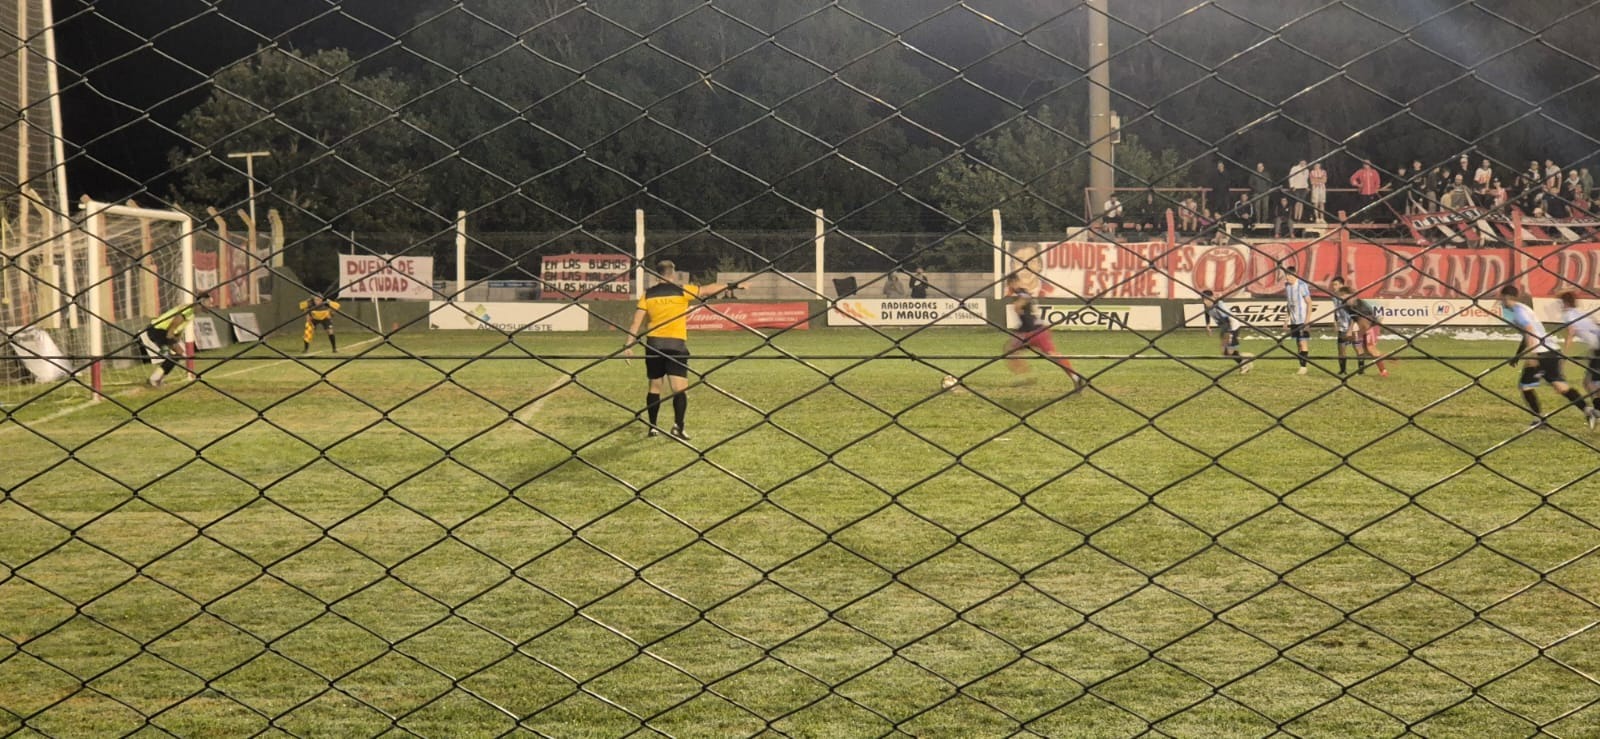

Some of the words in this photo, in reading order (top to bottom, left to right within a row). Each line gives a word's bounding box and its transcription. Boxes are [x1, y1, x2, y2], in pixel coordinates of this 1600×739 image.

[1047, 243, 1109, 271] DONDE
[398, 260, 415, 275] DE
[563, 258, 581, 270] LAS
[369, 276, 409, 292] CIUDAD
[881, 302, 937, 310] RADIADORES
[1373, 305, 1429, 317] Marconi
[881, 311, 894, 320] DI
[897, 311, 938, 320] MAURO
[1038, 306, 1130, 330] TORCEN
